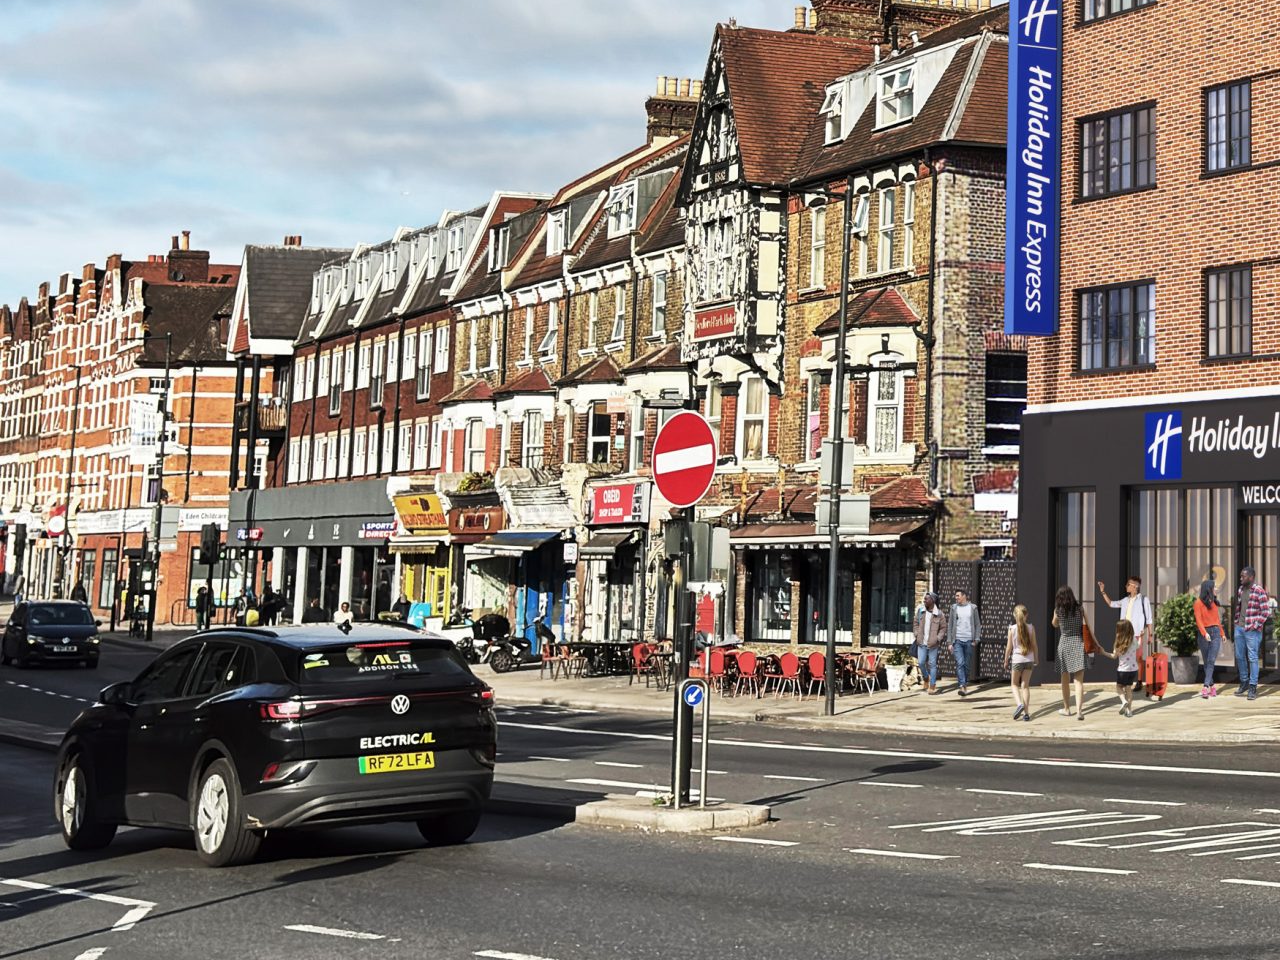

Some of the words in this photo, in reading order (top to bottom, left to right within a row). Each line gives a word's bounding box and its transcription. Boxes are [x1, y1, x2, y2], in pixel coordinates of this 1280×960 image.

[1022, 65, 1052, 170] Holiday
[1026, 171, 1051, 215] Inn
[1021, 219, 1047, 314] Express
[1188, 415, 1269, 459] Holiday
[201, 512, 227, 520] Childcare
[366, 530, 394, 538] DIRECT
[358, 665, 399, 673] ADDISON
[359, 732, 436, 750] ELECTRICAL
[369, 755, 404, 770] RF72
[407, 751, 432, 767] LFA
[888, 808, 1162, 836] NO
